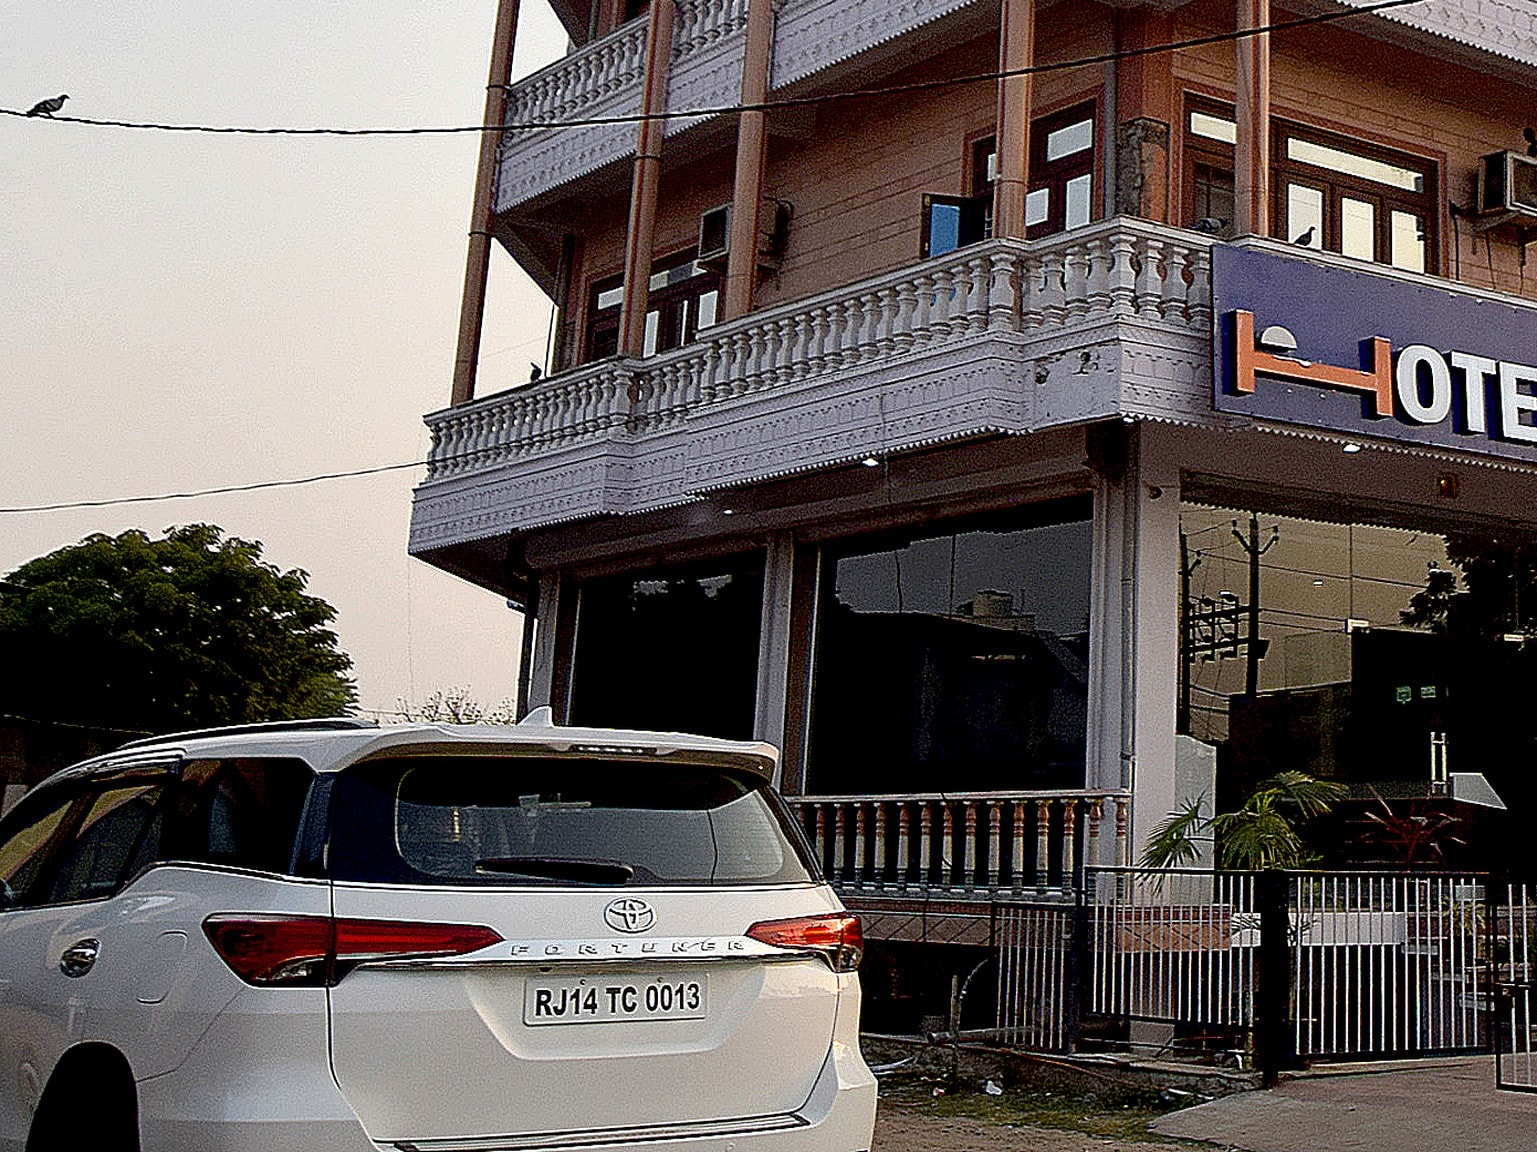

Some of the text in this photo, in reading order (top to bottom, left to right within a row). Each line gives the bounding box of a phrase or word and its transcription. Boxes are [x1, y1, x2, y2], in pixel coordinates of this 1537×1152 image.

[510, 939, 745, 956] FORTUNER
[535, 983, 701, 1017] RJ14 TC 0013
